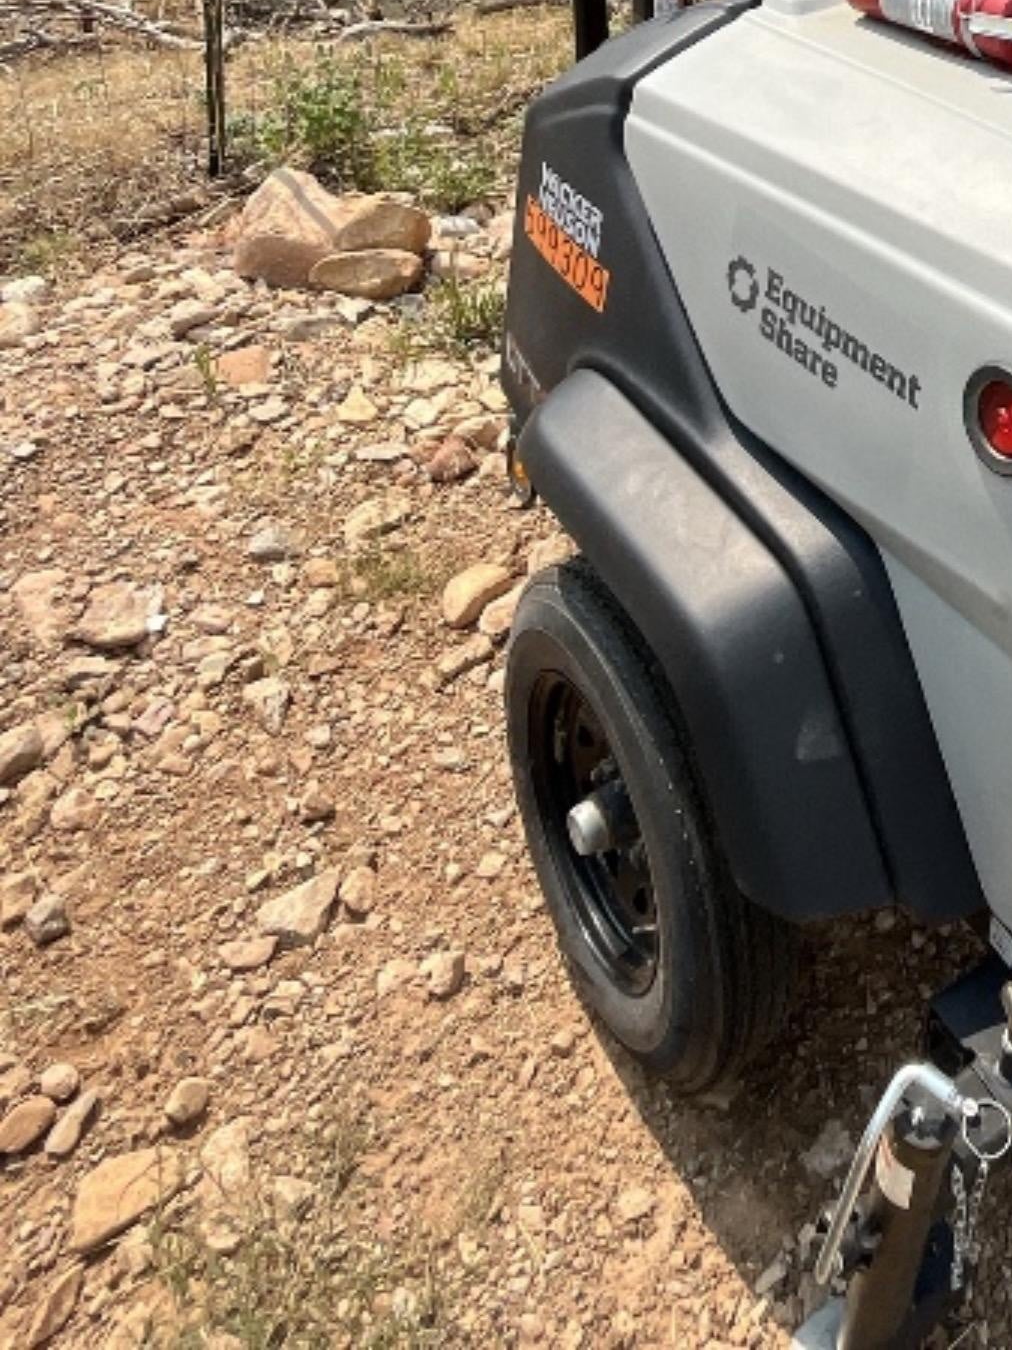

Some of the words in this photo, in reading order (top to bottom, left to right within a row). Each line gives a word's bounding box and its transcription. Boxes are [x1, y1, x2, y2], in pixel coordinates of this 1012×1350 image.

[539, 184, 602, 259] NEUSON
[540, 161, 604, 230] WACKER
[758, 307, 838, 390] Share
[763, 266, 922, 410] Equipment
